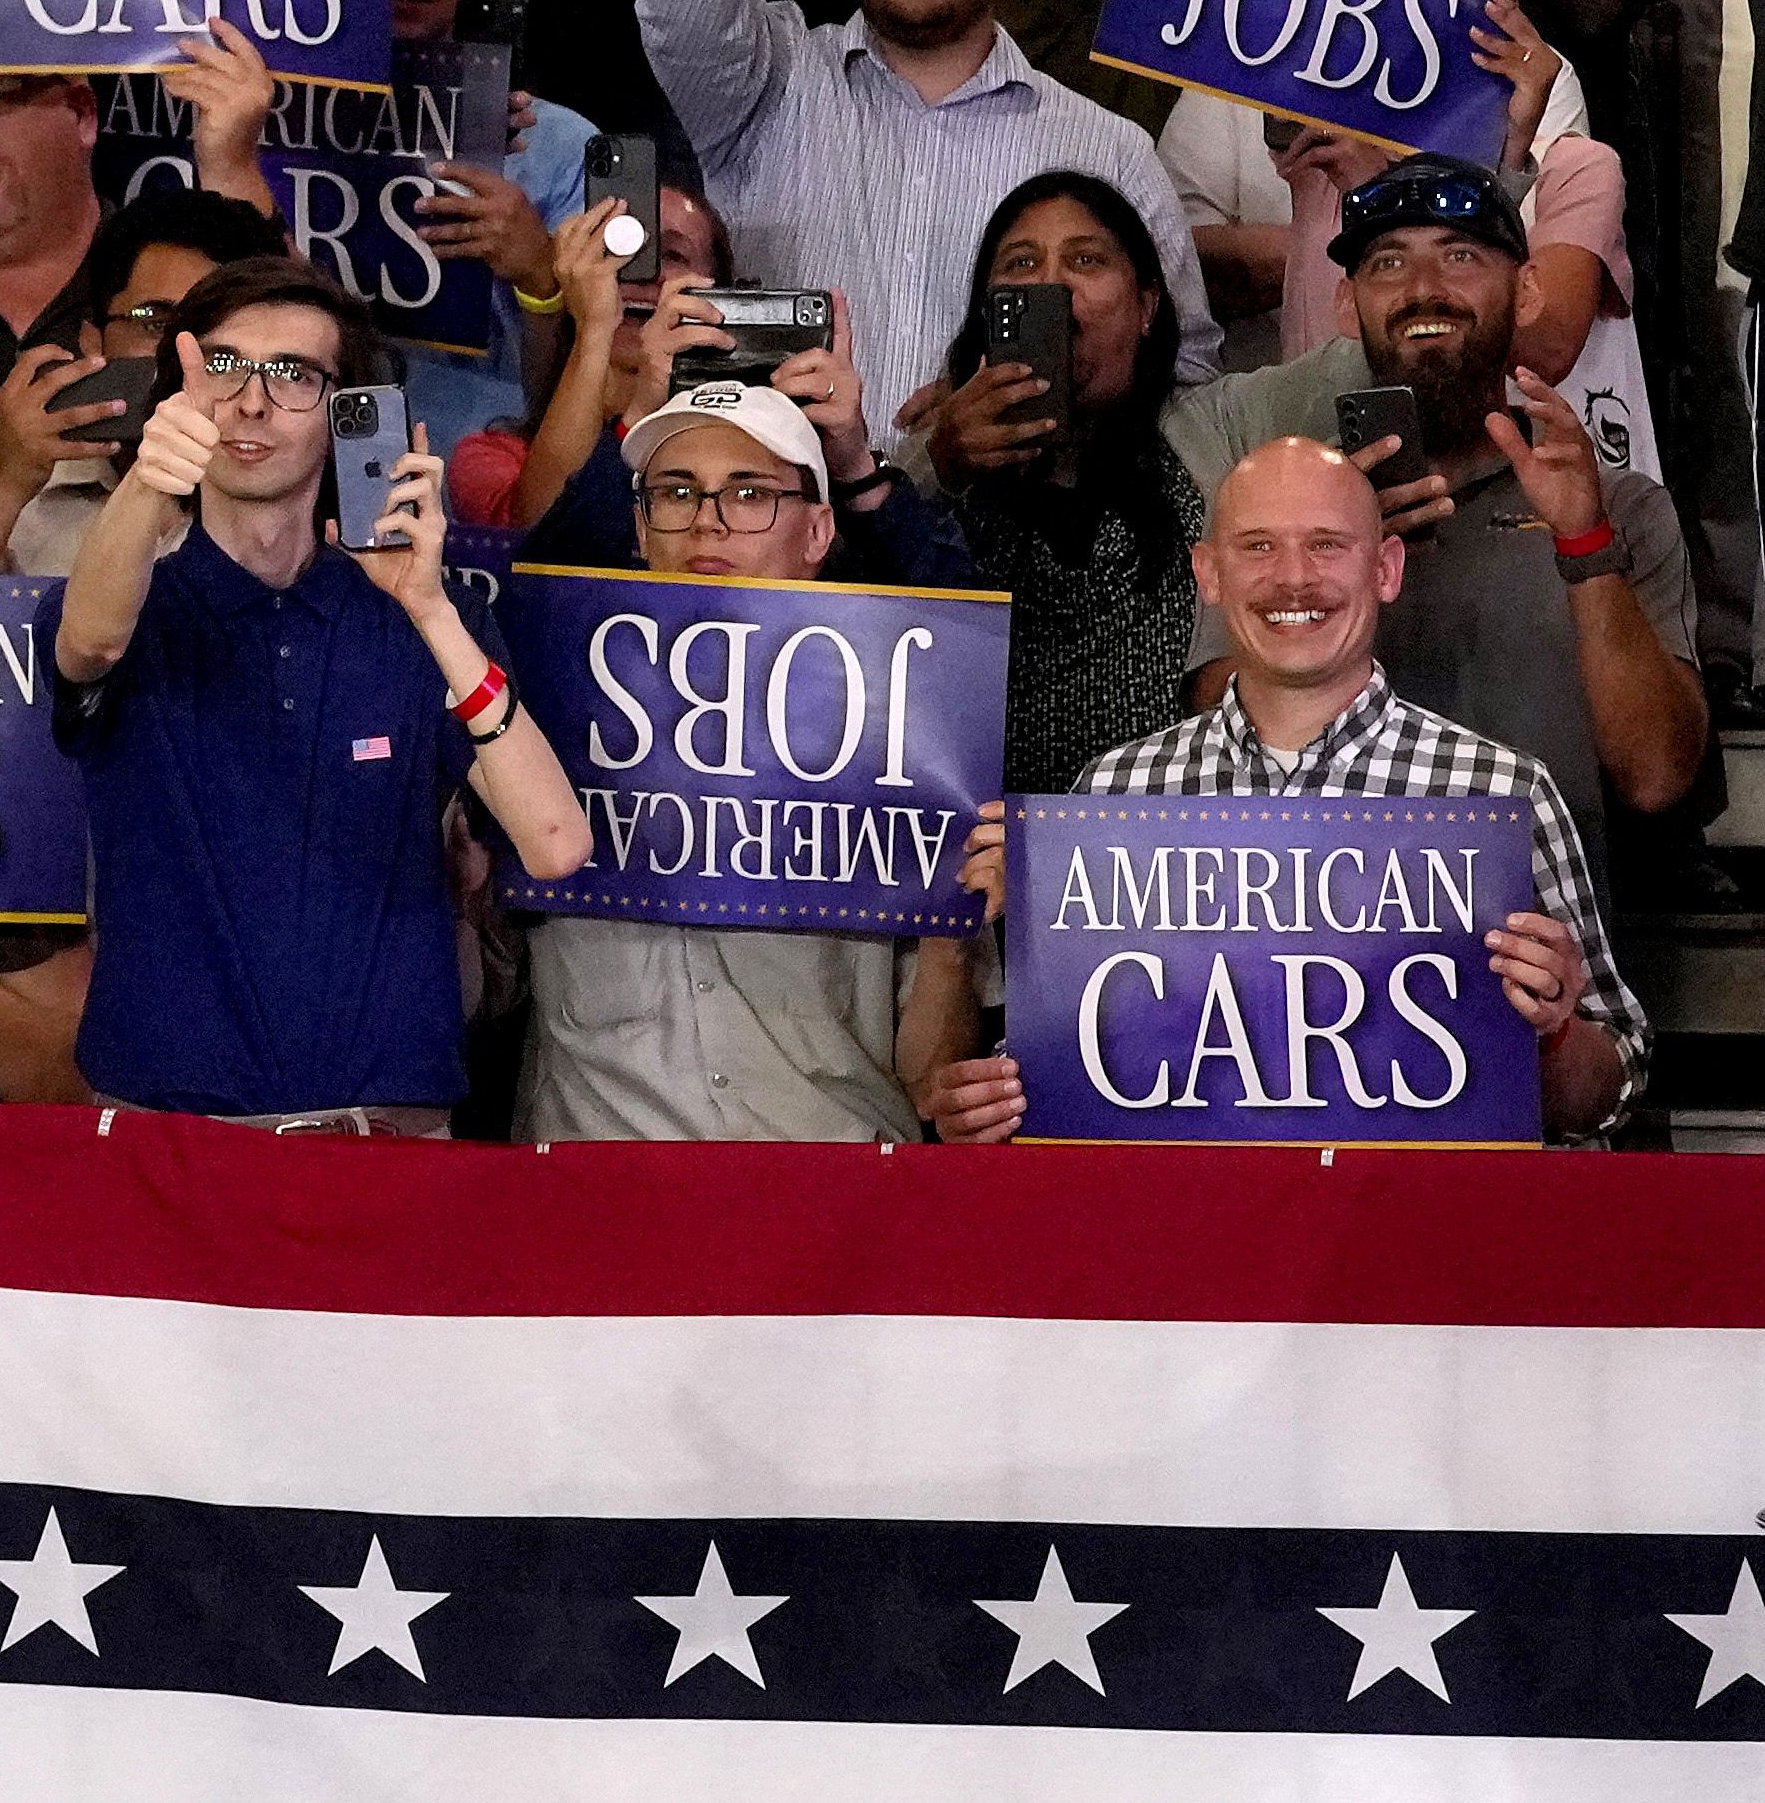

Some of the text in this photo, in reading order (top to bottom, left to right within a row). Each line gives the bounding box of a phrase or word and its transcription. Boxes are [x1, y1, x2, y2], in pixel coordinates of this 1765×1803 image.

[102, 73, 463, 160] AMRICAN
[589, 613, 934, 787] JOBS
[1050, 844, 1480, 934] AMERICAN
[1077, 950, 1467, 1110] CARS
